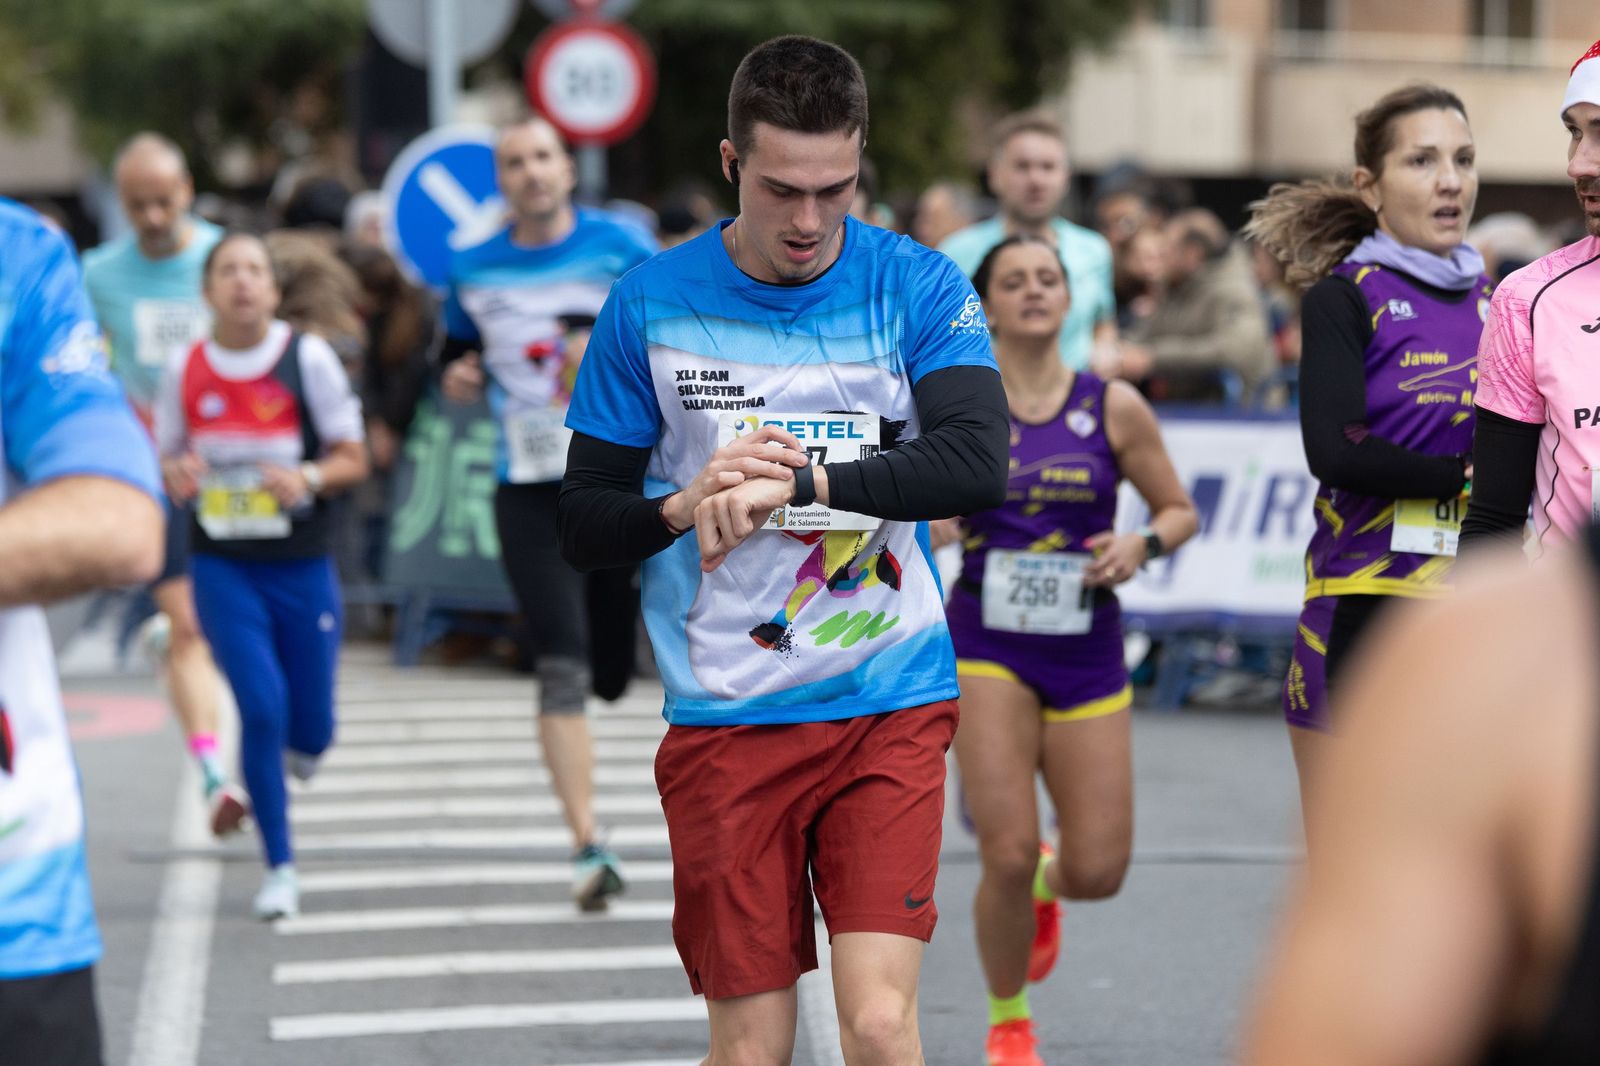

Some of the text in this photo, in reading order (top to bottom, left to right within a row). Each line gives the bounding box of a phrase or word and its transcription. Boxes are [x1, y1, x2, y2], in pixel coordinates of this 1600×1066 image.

[1399, 350, 1448, 367] Jamón
[675, 370, 729, 382] XLI SAN
[677, 384, 744, 397] SILVESTRE
[682, 396, 766, 411] SALMANTINA
[788, 510, 830, 518] Ayuntamiento
[1007, 575, 1060, 607] 258
